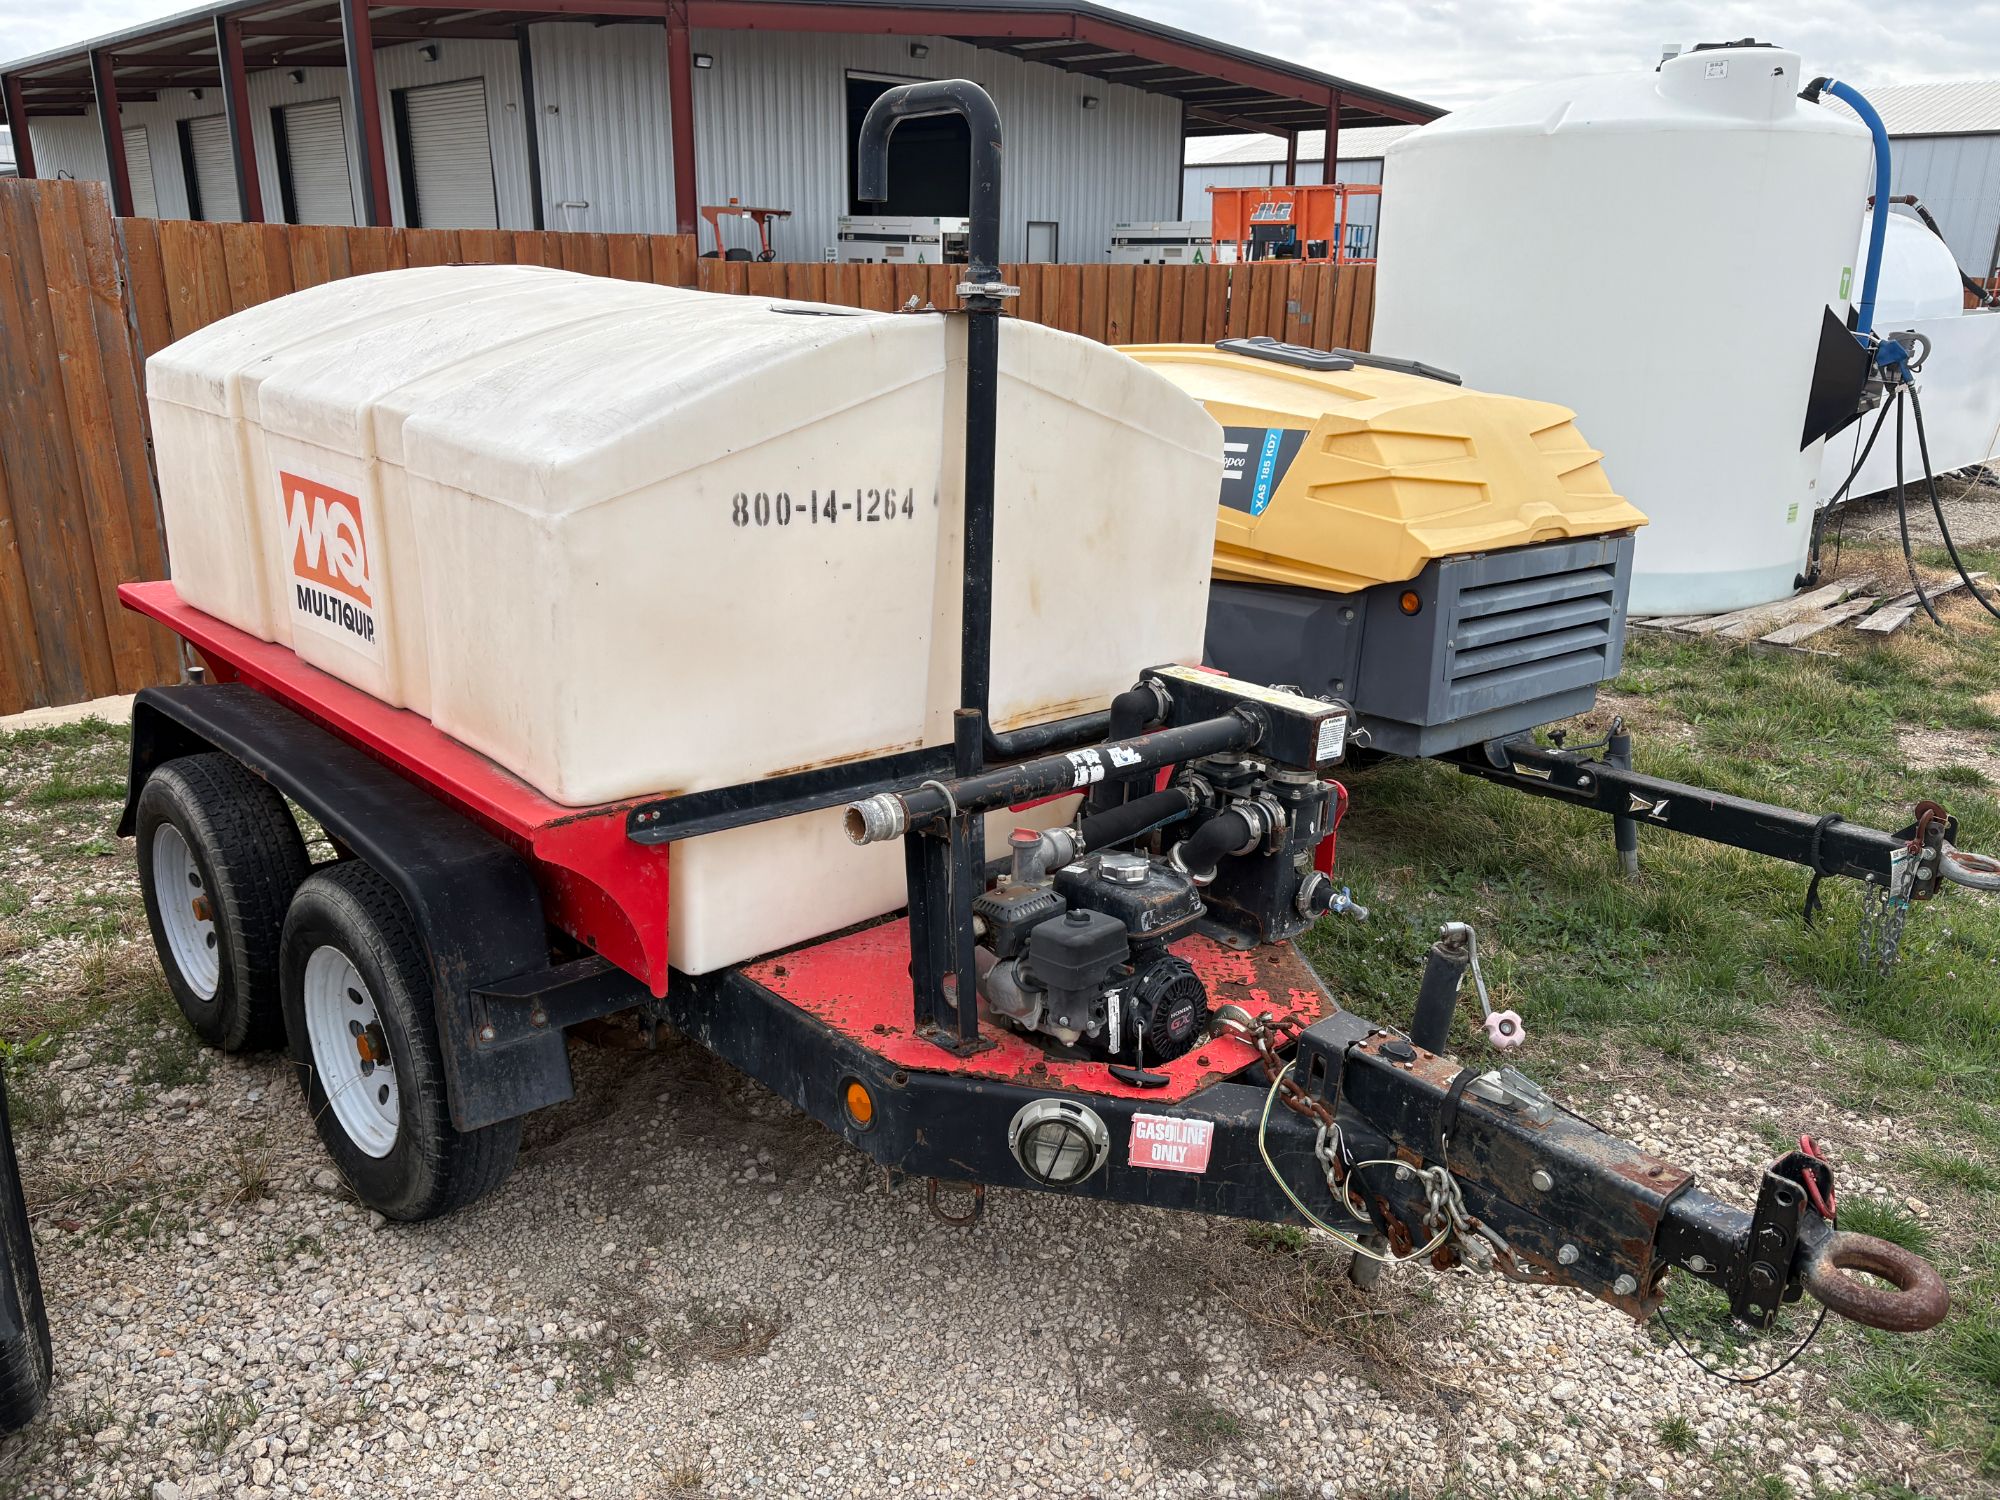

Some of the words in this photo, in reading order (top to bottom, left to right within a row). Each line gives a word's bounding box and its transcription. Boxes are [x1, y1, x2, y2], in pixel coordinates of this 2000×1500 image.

[1251, 202, 1294, 221] JLG
[1255, 484, 1267, 508] XAS
[1261, 461, 1271, 480] 185
[1266, 433, 1278, 457] KD7
[732, 488, 914, 527] 800-14-1264
[1170, 1005, 1192, 1019] HONDA
[1171, 1012, 1192, 1030] GX
[1136, 1121, 1206, 1145] GASOLINE
[1151, 1143, 1188, 1163] ONLY
